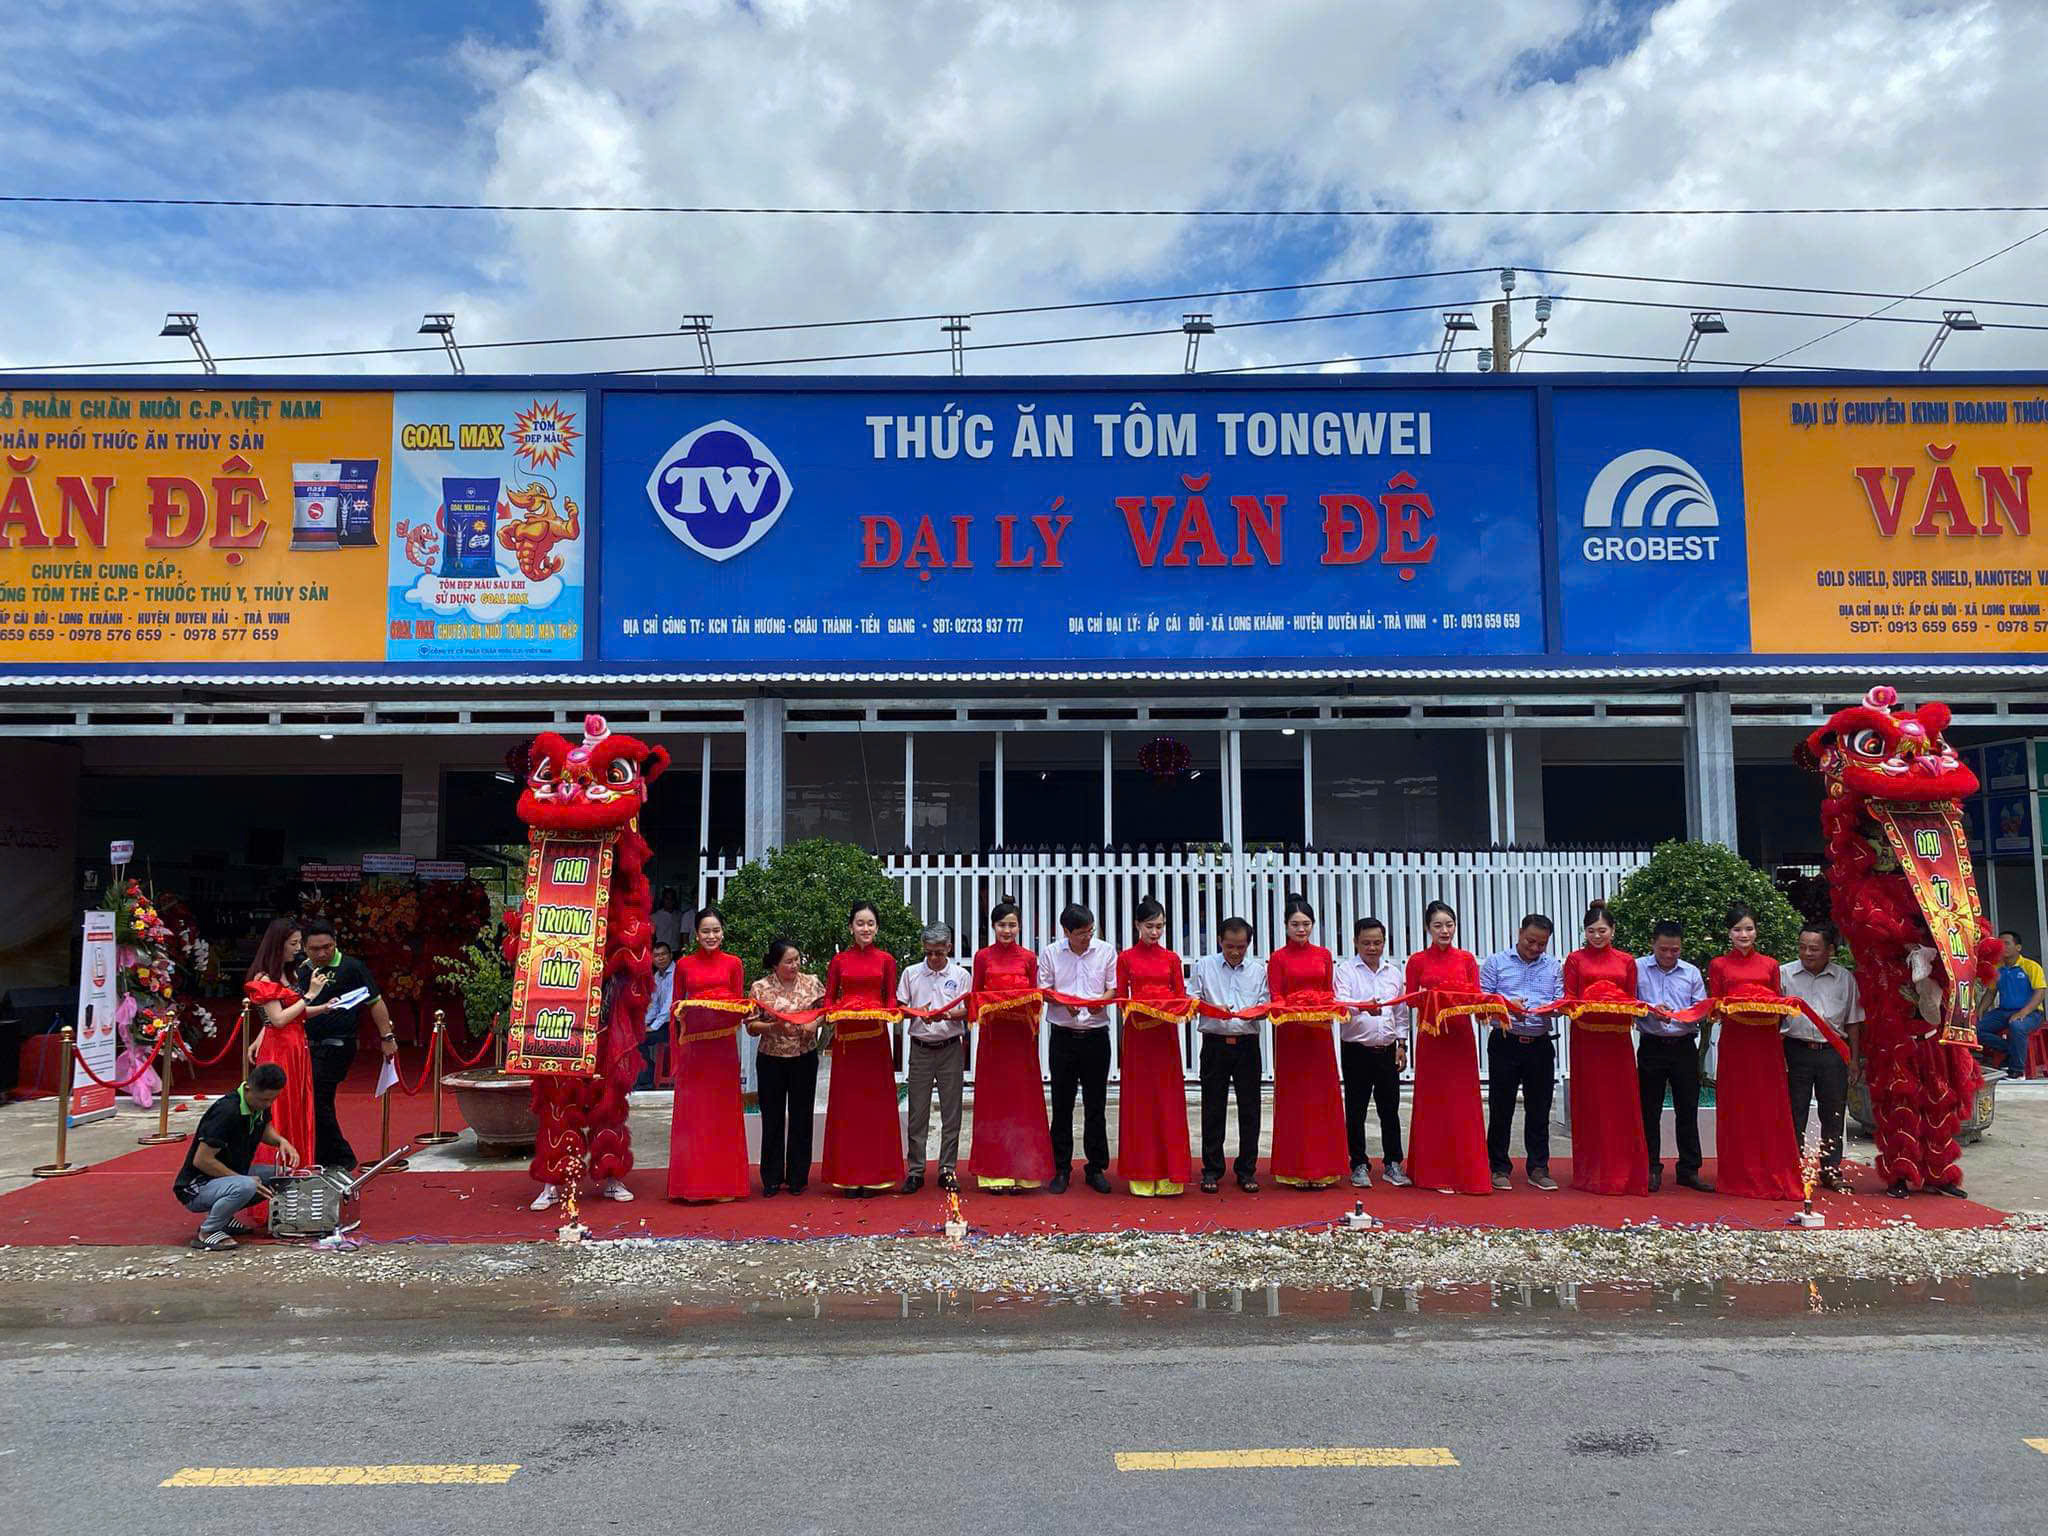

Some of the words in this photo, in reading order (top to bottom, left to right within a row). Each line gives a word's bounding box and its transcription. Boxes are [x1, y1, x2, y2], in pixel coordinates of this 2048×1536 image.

[280, 400, 322, 418] NAM
[1791, 401, 1818, 430] ĐẠI
[1823, 398, 1839, 424] LÝ
[1844, 397, 1906, 424] CHUYÊN
[1911, 401, 1949, 424] KINH
[1954, 401, 2007, 424] DOANH
[533, 418, 556, 431] TÔM
[866, 402, 994, 460] THỨC
[1011, 403, 1073, 458] ĂN
[1094, 402, 1198, 458] TÔM
[1217, 412, 1431, 456] TONGWEI
[0, 428, 39, 449] HÂN
[45, 426, 86, 449] PHỐI
[92, 429, 138, 449] THỨC
[145, 429, 168, 449] ĂN
[175, 428, 221, 449] THỦY
[229, 428, 264, 450] SẢN
[402, 424, 455, 450] GOAL
[459, 424, 505, 450] MAX
[665, 466, 772, 514] TW
[1853, 442, 2033, 536] VĂN
[145, 454, 269, 566] ĐỆ
[859, 514, 974, 582] ĐẠI
[995, 496, 1073, 569] LÝ
[1114, 472, 1288, 568] VĂN
[1319, 471, 1438, 582] ĐỆ
[1583, 535, 1720, 561] GROBEST
[32, 561, 92, 579] CHUYÊN
[99, 563, 138, 579] CUNG
[1816, 570, 1845, 587] GOLD
[1848, 570, 1889, 589] SHIELD,
[1892, 570, 1927, 587] SUPER
[1932, 570, 1972, 589] SHIELD,
[1975, 570, 2032, 587] NANOTECH
[32, 583, 65, 601] TÔM
[71, 582, 99, 601] THẺ
[145, 580, 196, 601] THUỐC
[201, 582, 231, 601] THÚ
[255, 581, 294, 601] THỦY
[299, 581, 328, 601] SẢN
[440, 579, 456, 589] TÔM
[493, 581, 509, 589] SAU
[511, 580, 525, 589] KHI
[480, 592, 506, 604] GOAL
[507, 592, 529, 604] MAX
[59, 612, 83, 624] LONG
[268, 612, 290, 624] VINH
[1982, 604, 2005, 616] LONG
[623, 618, 639, 637] ĐỊA
[662, 616, 687, 634] CÔNG
[708, 618, 728, 634] KCN
[731, 615, 750, 634] TÂN
[794, 616, 817, 634] CHÂU
[822, 615, 852, 634] THÀNH
[887, 617, 916, 634] GIANG
[954, 617, 982, 633] 02733
[985, 617, 1002, 633] 937
[1006, 617, 1024, 633] 777
[1228, 616, 1252, 631] LONG
[1253, 612, 1284, 631] KHÁNH
[1293, 612, 1323, 633] HUYỆN
[1328, 612, 1357, 630] DUYÊN
[1384, 611, 1401, 630] TRÀ
[1404, 614, 1426, 629] VINH
[1461, 613, 1483, 629] 0913
[1484, 613, 1502, 629] 659
[1503, 613, 1520, 629] 659
[1850, 621, 1883, 633] SĐT:
[1888, 621, 1917, 633] 0913
[1922, 621, 1947, 633] 659
[1952, 621, 1977, 633] 659
[1997, 621, 2028, 633] 0978
[0, 629, 24, 641] 659
[29, 629, 54, 641] 659
[69, 629, 102, 641] 0978
[107, 629, 132, 641] 576
[136, 629, 162, 641] 659
[183, 629, 217, 641] 0978
[222, 629, 247, 641] 577
[252, 629, 279, 641] 659
[553, 858, 588, 884] KHAI
[538, 906, 592, 936] TRƯƠNG
[535, 1008, 573, 1040] PHÁT
